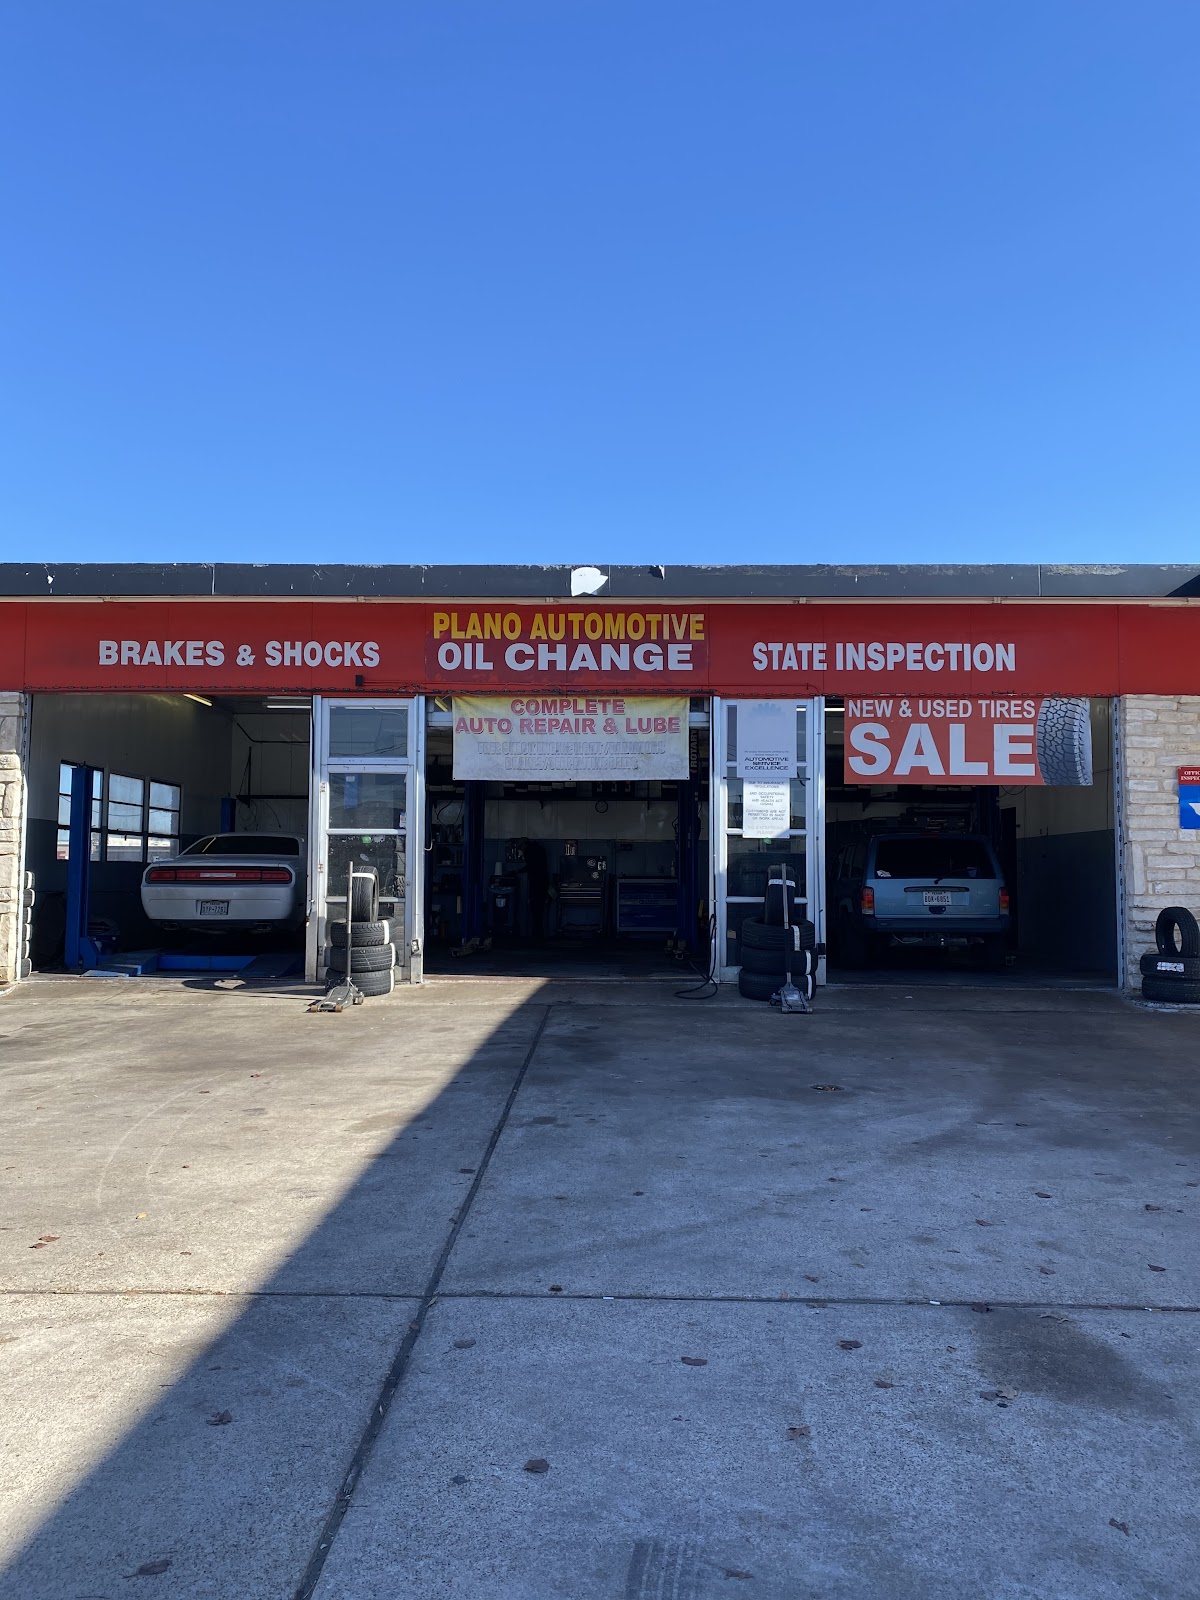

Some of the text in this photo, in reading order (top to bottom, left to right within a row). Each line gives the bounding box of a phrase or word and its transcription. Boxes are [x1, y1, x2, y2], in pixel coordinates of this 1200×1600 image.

[433, 612, 705, 641] PLANO AUTOMOTIVE
[98, 640, 380, 667] BRAKES & SHOCKS
[437, 642, 693, 671] OIL CHANGE
[752, 642, 1016, 671] STATE INSPECTION
[510, 698, 626, 716] COMPLETE
[848, 699, 1036, 719] NEW & USED TIRES
[455, 716, 681, 735] AUTO REPAIR & LUBE
[848, 721, 1036, 776] SALE
